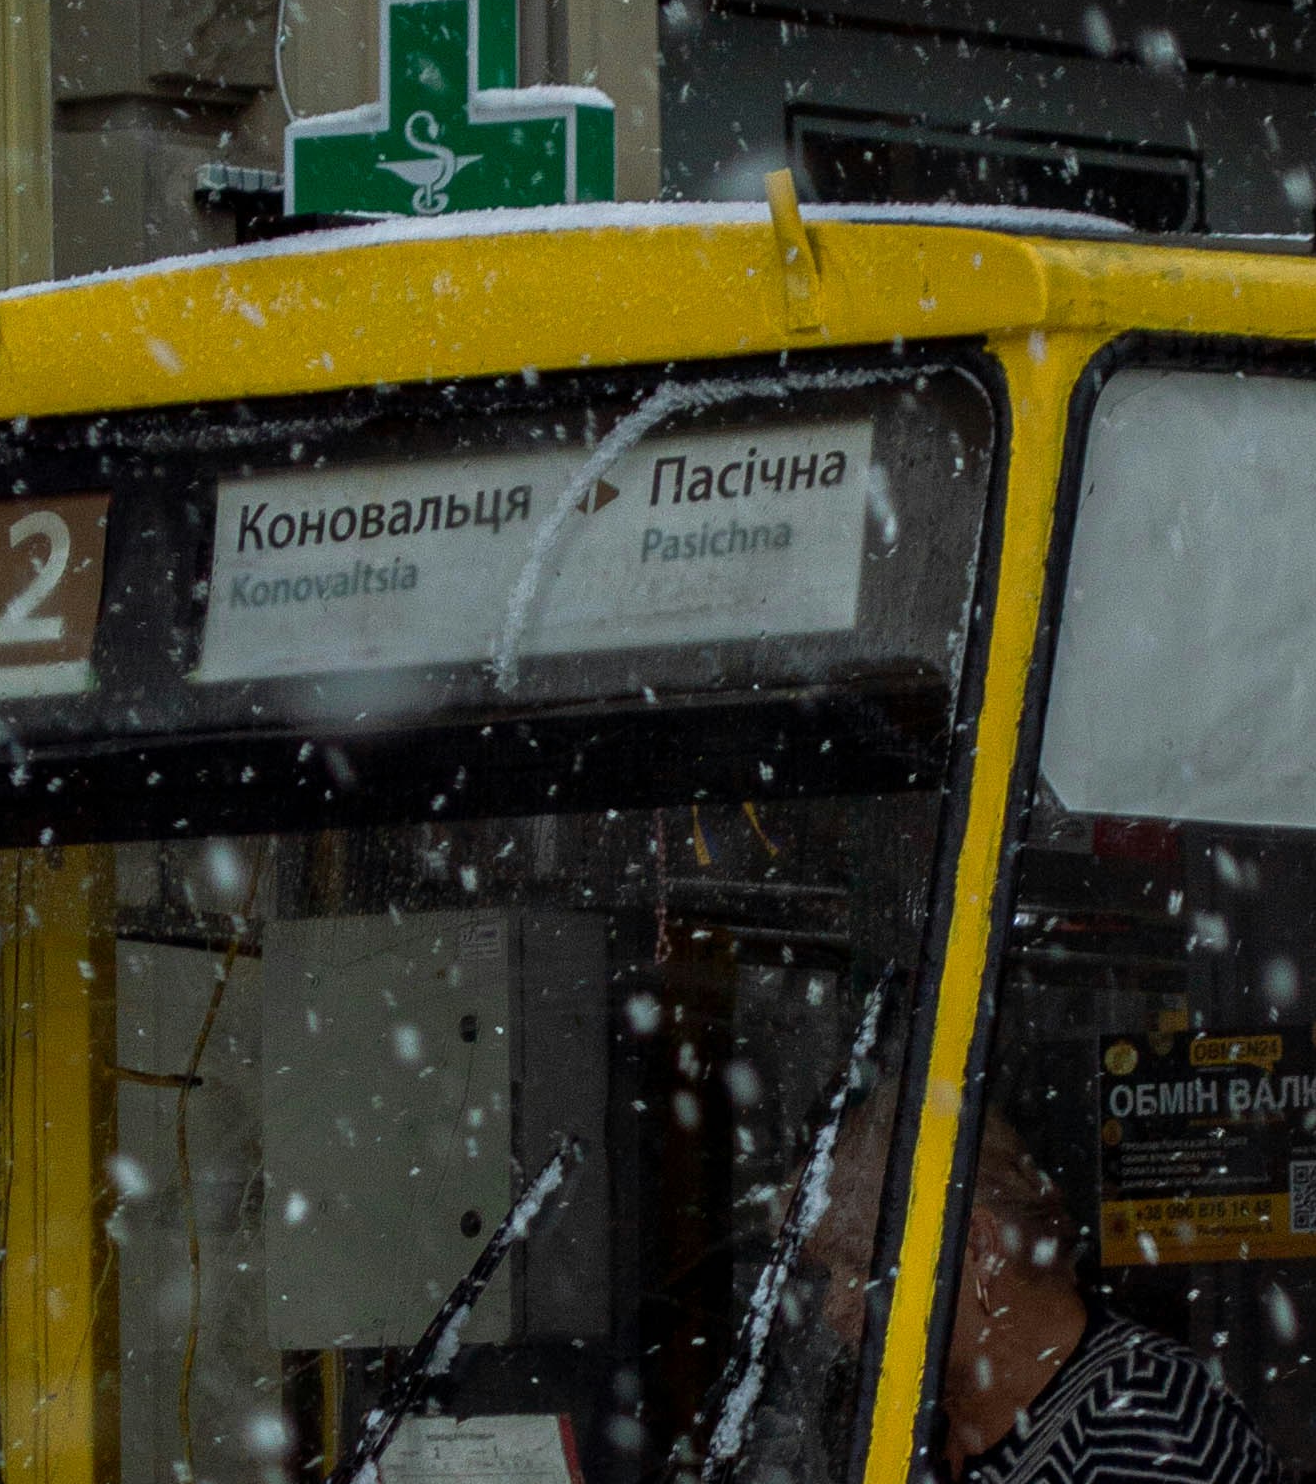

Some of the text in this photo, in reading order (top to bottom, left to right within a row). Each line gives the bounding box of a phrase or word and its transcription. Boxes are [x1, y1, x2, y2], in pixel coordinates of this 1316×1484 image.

[235, 443, 847, 553] Коновальця Пасічна
[228, 515, 794, 611] Konovaltsia Pasichna
[1109, 1079, 1219, 1117] ОБМІН
